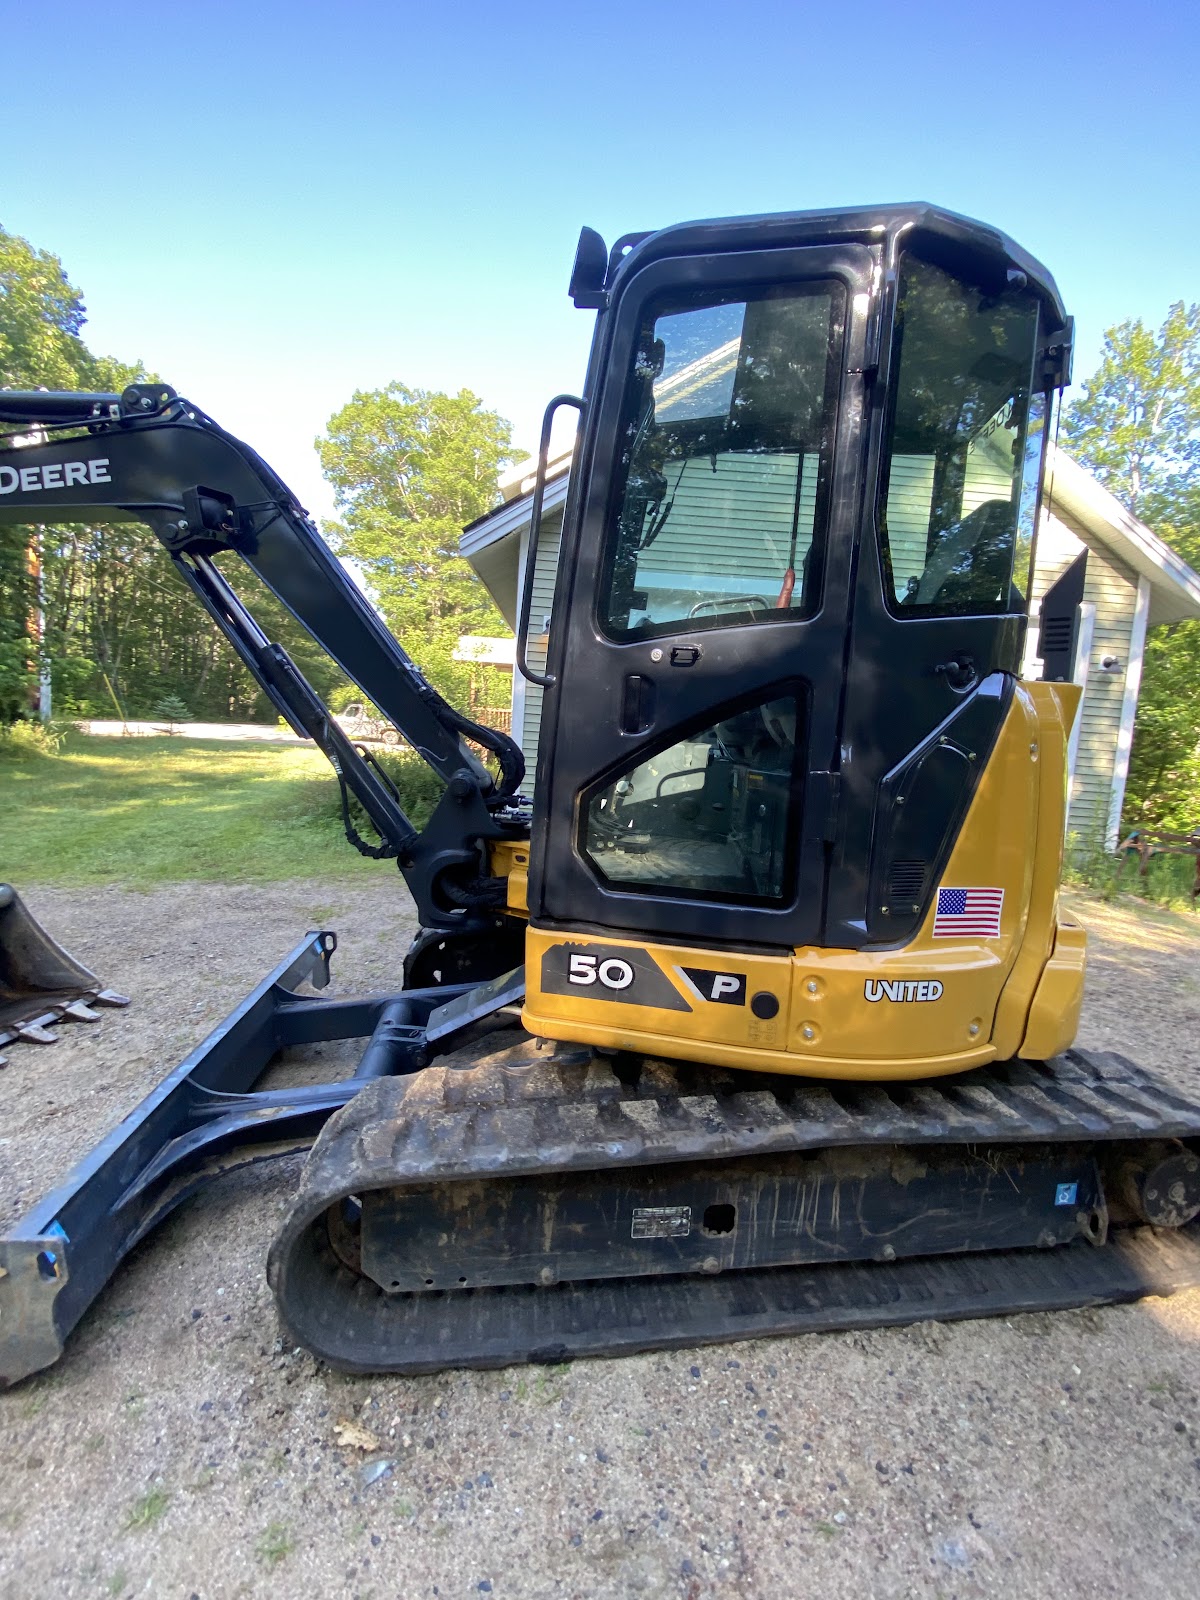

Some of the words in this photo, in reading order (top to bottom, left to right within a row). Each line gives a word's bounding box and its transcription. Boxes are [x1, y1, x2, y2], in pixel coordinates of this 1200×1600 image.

[0, 458, 112, 495] DEERE
[568, 952, 635, 991] 50
[710, 974, 741, 1000] P
[864, 979, 944, 1003] UNITED
